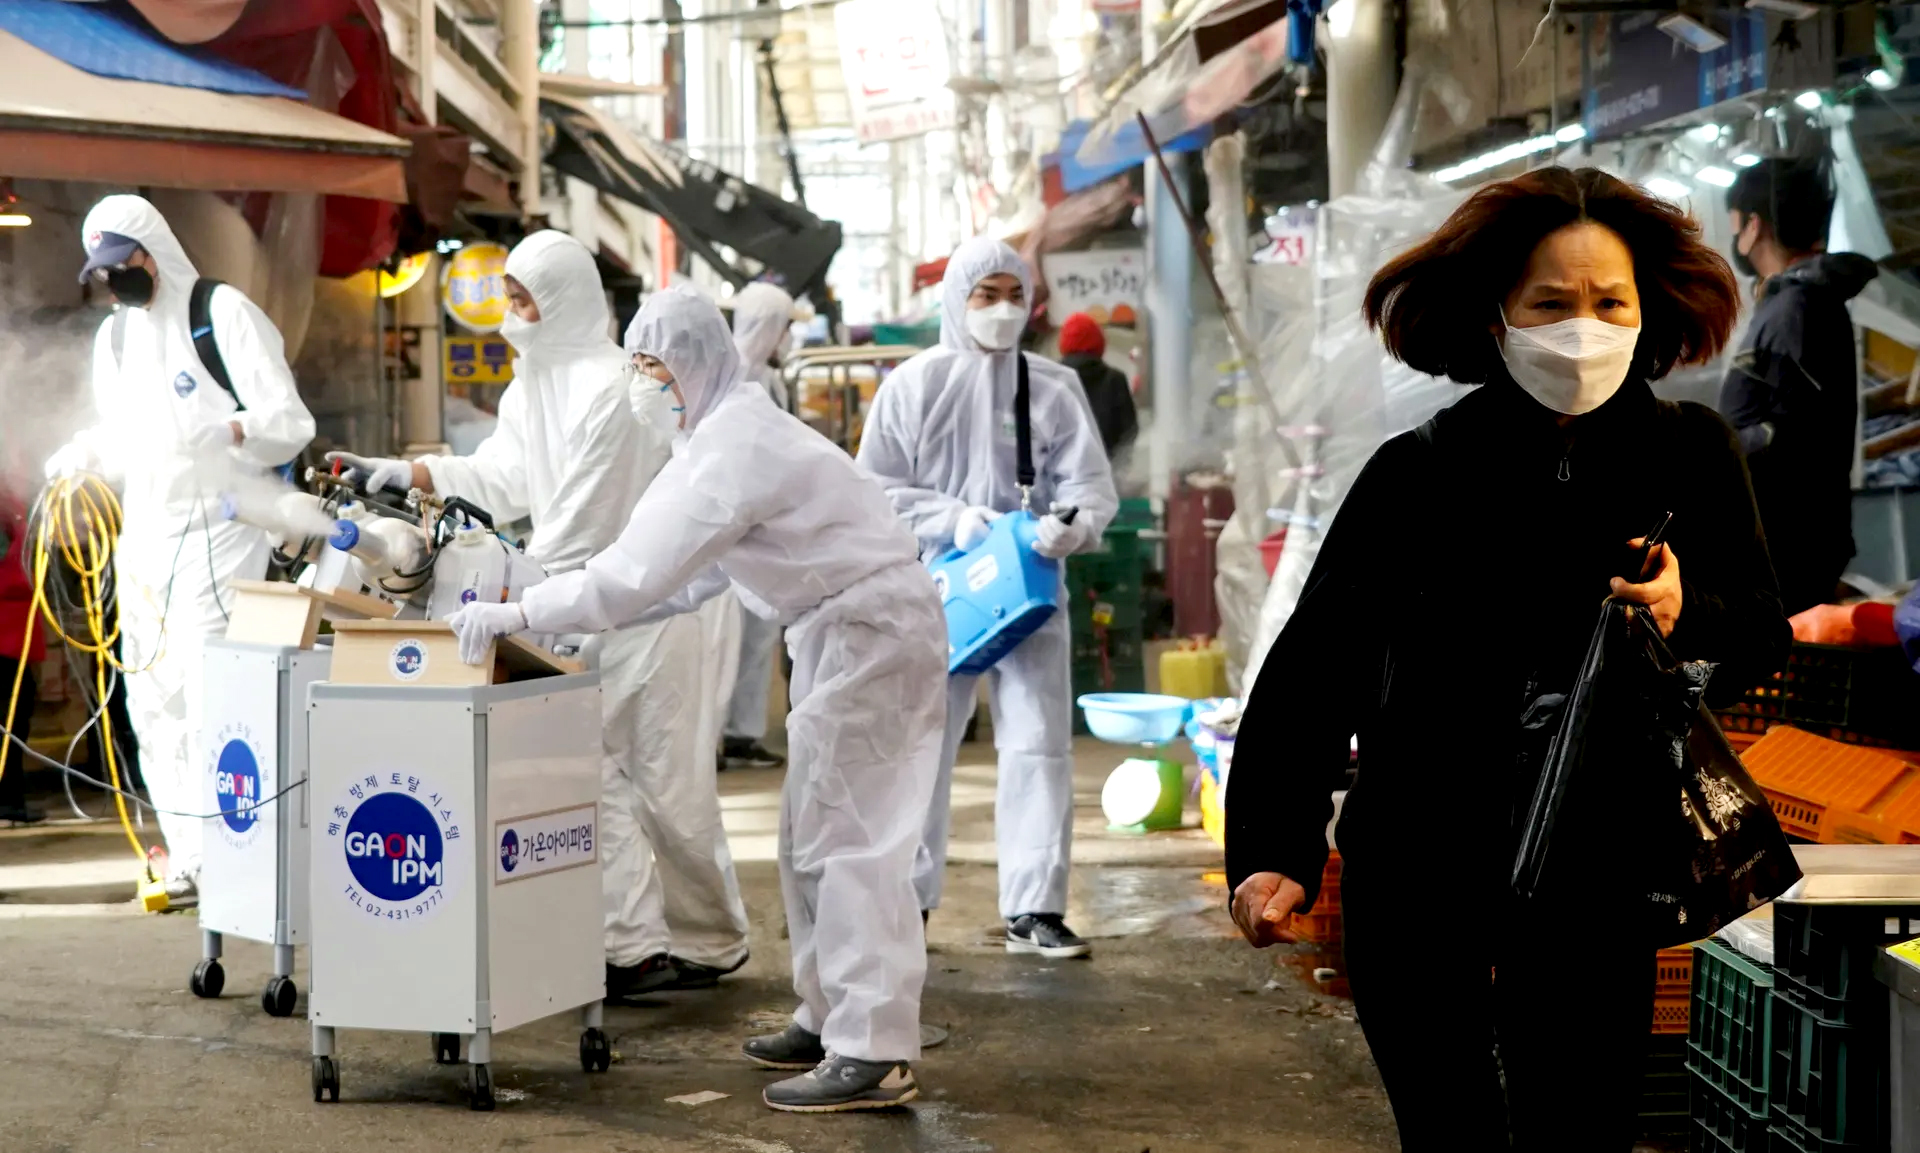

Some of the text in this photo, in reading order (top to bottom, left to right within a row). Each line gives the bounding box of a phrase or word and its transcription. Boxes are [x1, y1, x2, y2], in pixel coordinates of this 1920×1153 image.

[216, 770, 255, 798] GAON
[236, 796, 261, 821] IPM
[327, 772, 461, 840] 해충 방제 토탈 시스템
[345, 831, 427, 860] GAON
[523, 823, 593, 863] 가온아이피엠
[391, 858, 443, 886] IPM
[344, 884, 444, 920] TEL 02-431-9777
